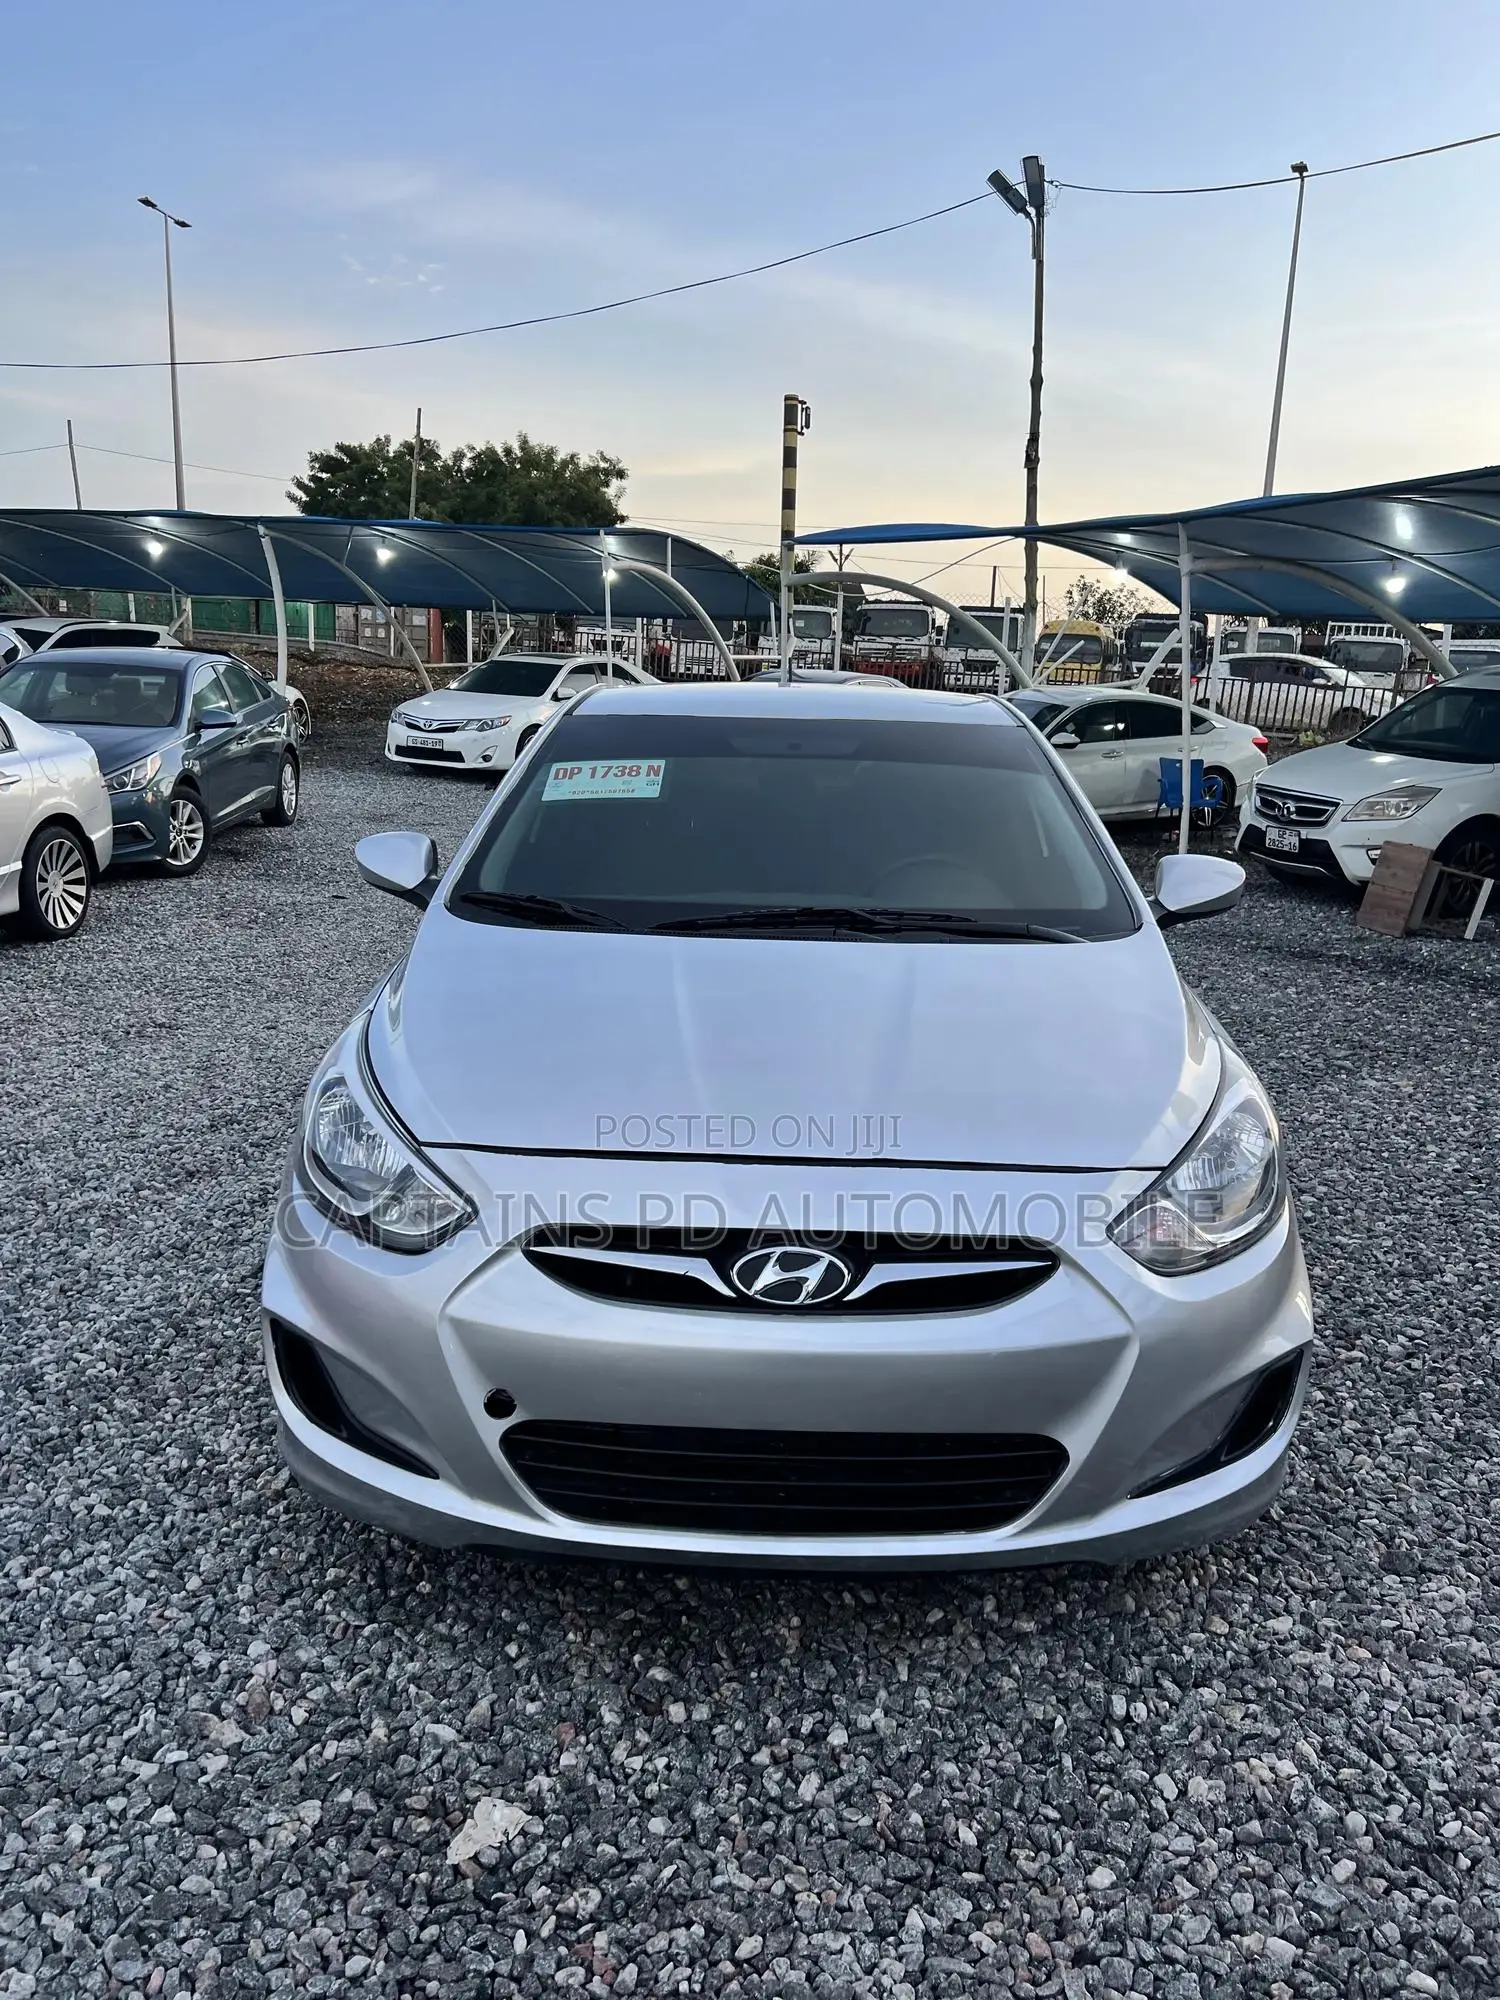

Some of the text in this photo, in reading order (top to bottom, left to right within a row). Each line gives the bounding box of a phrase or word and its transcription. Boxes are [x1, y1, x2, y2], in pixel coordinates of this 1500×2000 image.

[553, 764, 662, 781] DP 1738 N
[1267, 837, 1298, 851] 2825-16
